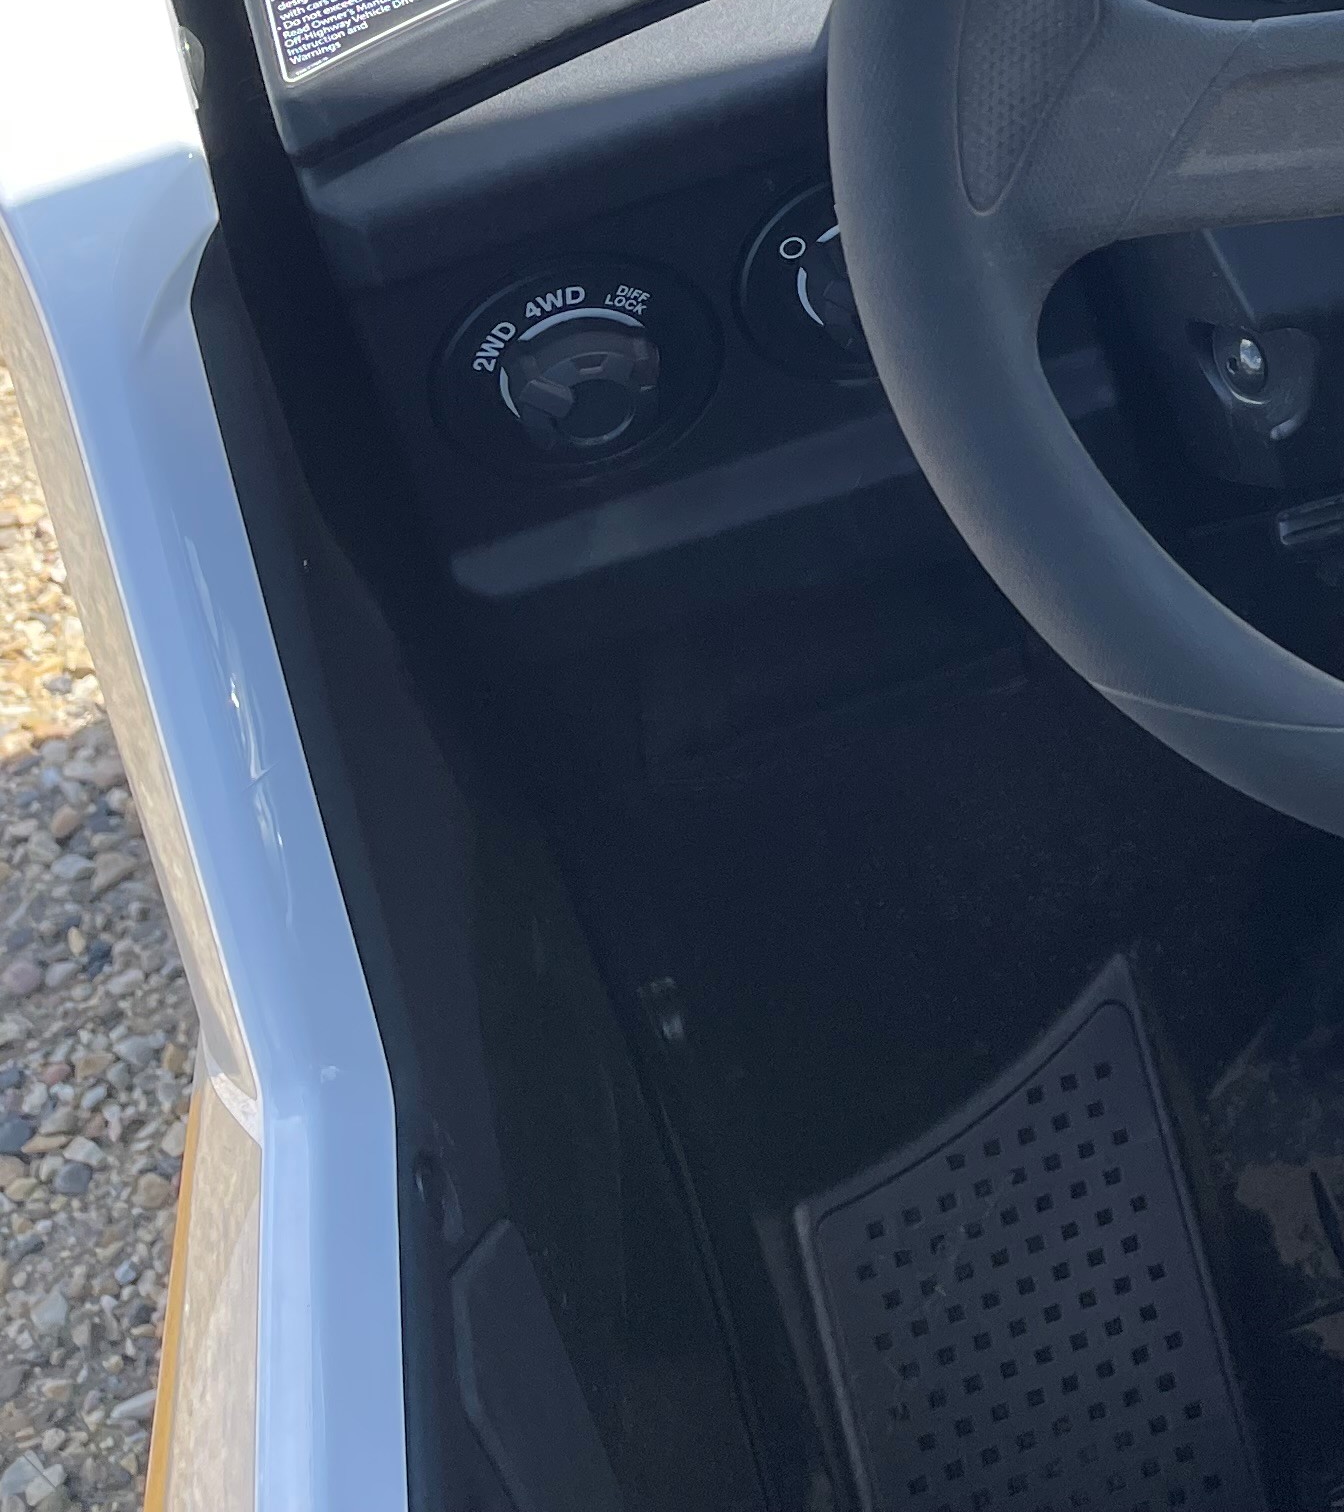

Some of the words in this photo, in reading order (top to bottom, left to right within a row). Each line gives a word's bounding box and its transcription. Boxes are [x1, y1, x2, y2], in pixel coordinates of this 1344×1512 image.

[616, 285, 650, 302] DIFF
[605, 295, 648, 315] LOCK
[473, 320, 516, 373] 2WD
[525, 286, 586, 320] 4WD
